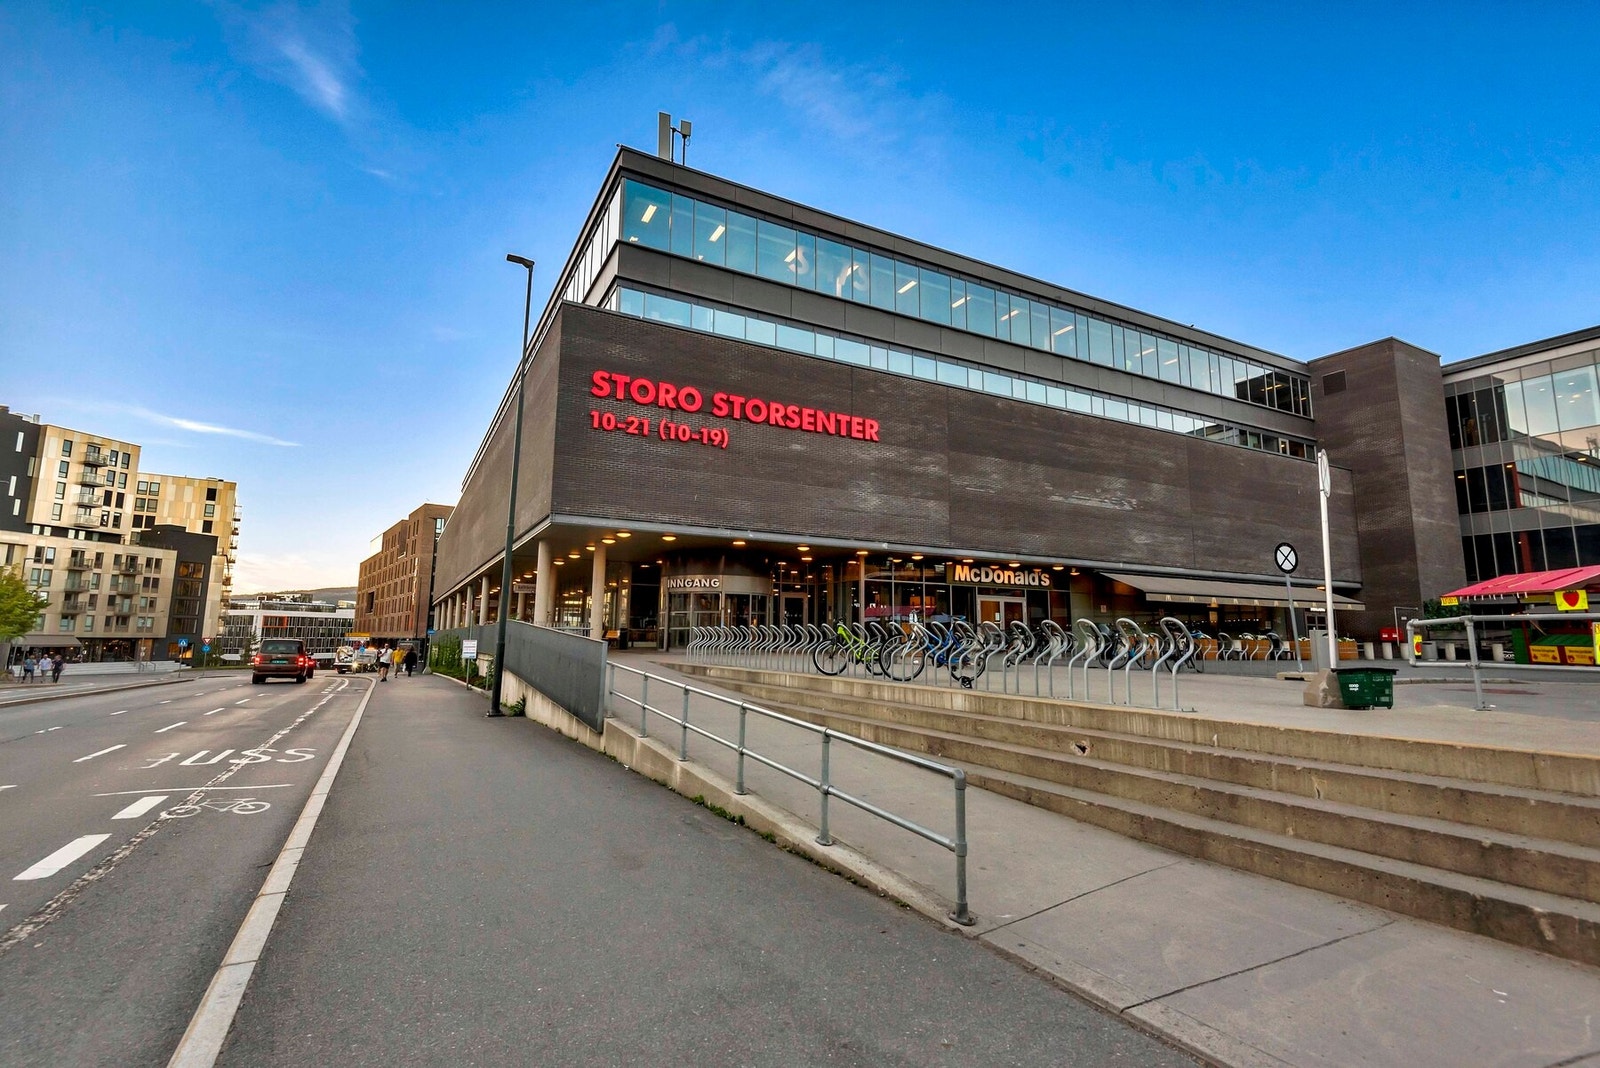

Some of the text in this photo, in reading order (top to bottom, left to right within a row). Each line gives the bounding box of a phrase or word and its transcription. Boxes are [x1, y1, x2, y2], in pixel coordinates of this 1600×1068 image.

[591, 370, 881, 442] STORO STORSENTER
[590, 410, 730, 449] 10-21 (10-19)
[667, 578, 720, 588] INNGANG
[954, 564, 1051, 587] McDonald's
